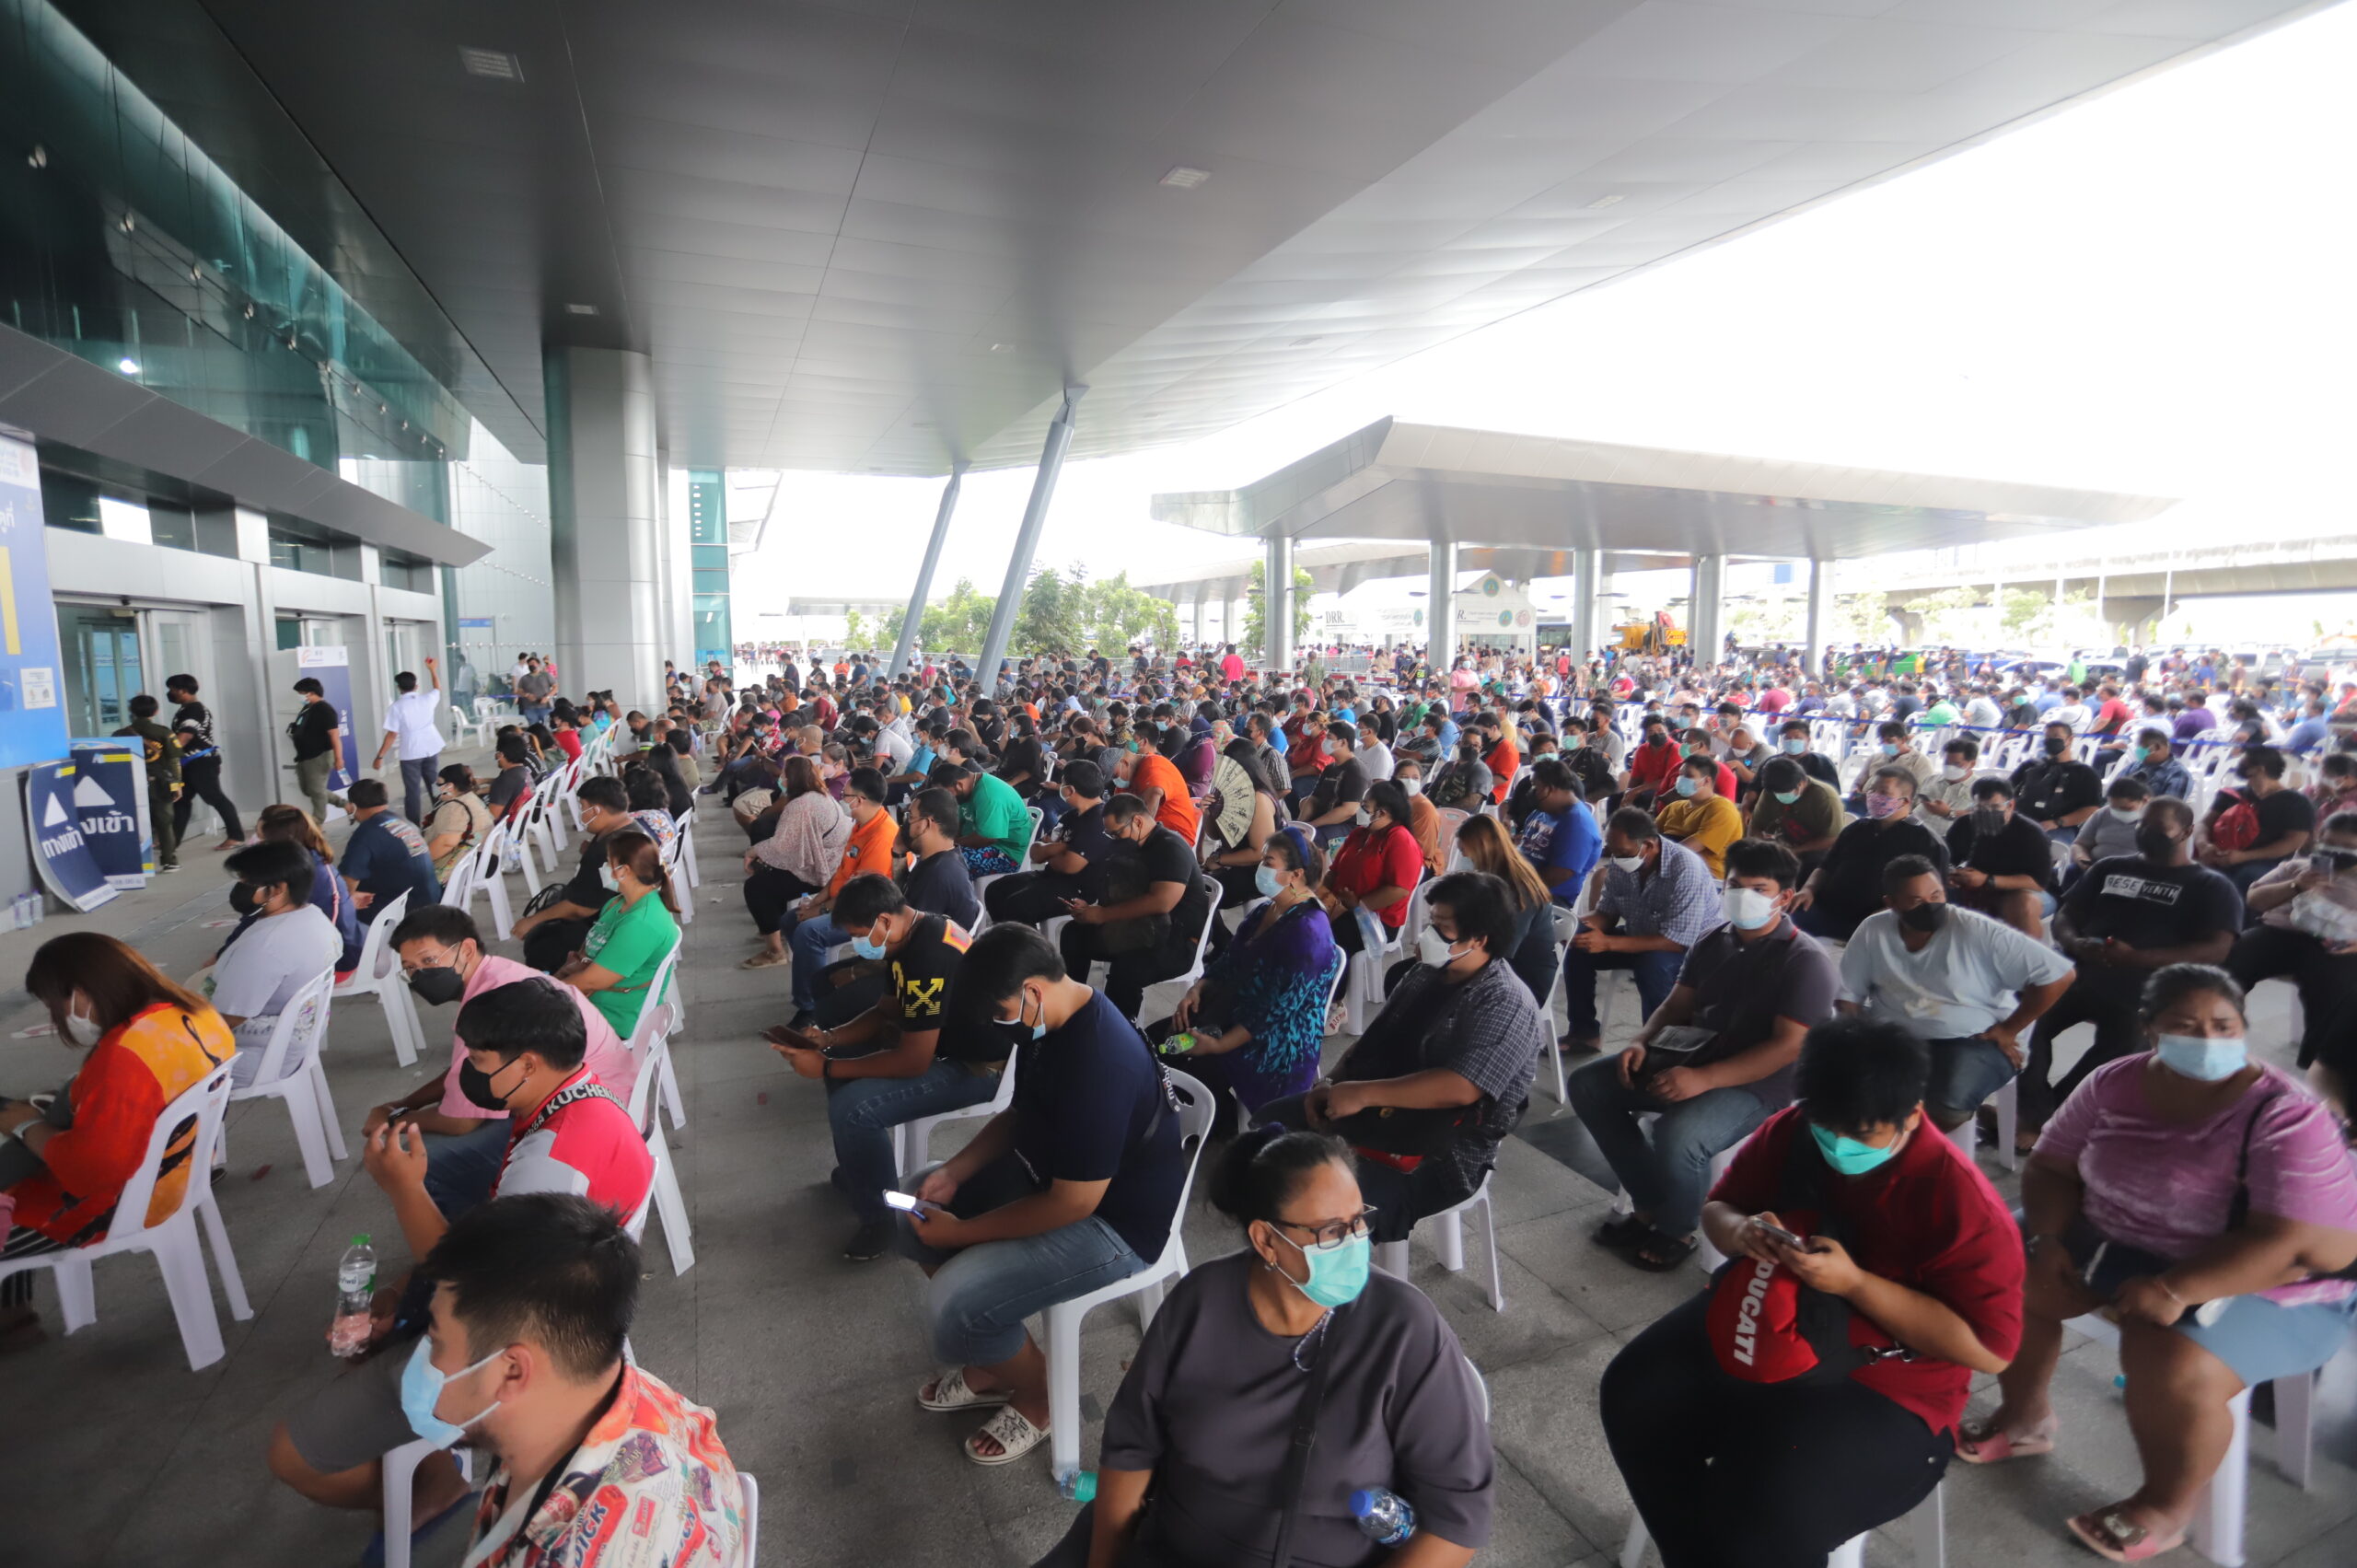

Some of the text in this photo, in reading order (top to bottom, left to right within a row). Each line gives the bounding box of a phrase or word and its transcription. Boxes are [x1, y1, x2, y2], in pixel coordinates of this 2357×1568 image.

[1325, 610, 1345, 624] DRR.
[1457, 609, 1467, 621] R.
[79, 810, 135, 835] งเข้า
[41, 825, 85, 858] ทางเข้า
[1734, 1260, 1774, 1366] DUCATI
